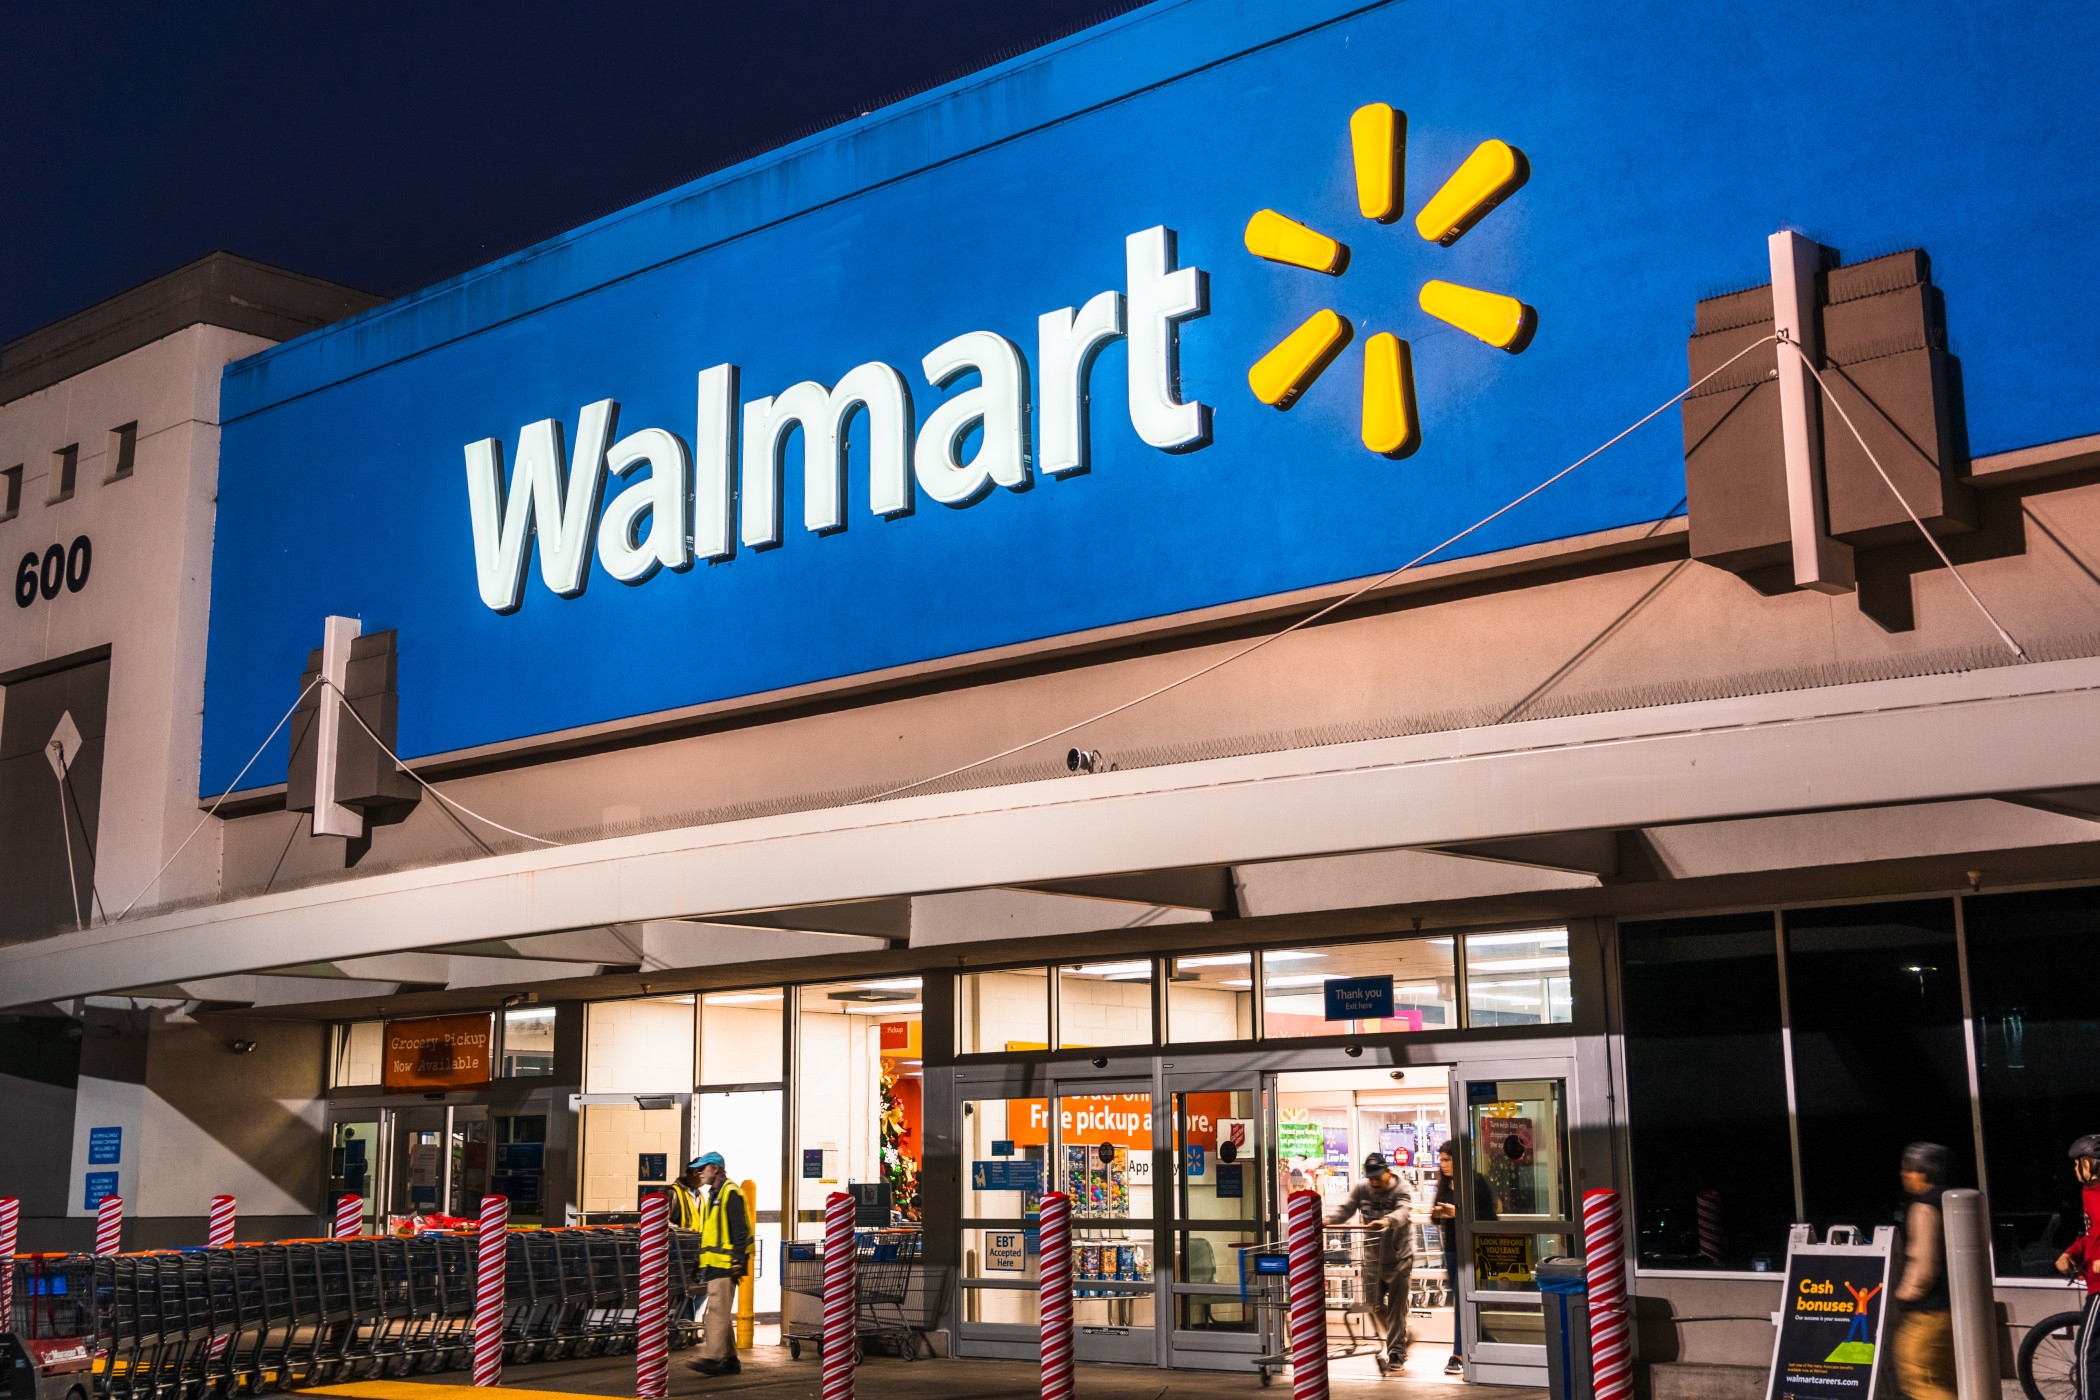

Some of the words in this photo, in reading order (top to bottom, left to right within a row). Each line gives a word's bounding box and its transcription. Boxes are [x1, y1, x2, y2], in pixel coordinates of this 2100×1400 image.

[463, 225, 1207, 613] Walmart
[15, 535, 92, 608] 600
[1335, 988, 1364, 1000] Thank
[1365, 989, 1382, 1001] you
[1345, 1002, 1358, 1010] Exit
[391, 1037, 439, 1052] Grocery
[444, 1032, 487, 1048] Pickup
[394, 1060, 413, 1073] Now
[418, 1056, 479, 1072] Available
[1030, 1104, 1072, 1129] Fre
[1076, 1105, 1140, 1136] pickup
[1128, 1160, 1149, 1175] App
[996, 1235, 1015, 1247] EBT
[1480, 1238, 1498, 1246] LOOK
[1500, 1238, 1524, 1246] BEFORE
[990, 1248, 1022, 1258] Accepted
[997, 1258, 1014, 1267] Here
[1800, 1279, 1834, 1294] Cash
[1796, 1296, 1854, 1313] bonuses
[1786, 1375, 1859, 1386] walmartcareers.com
